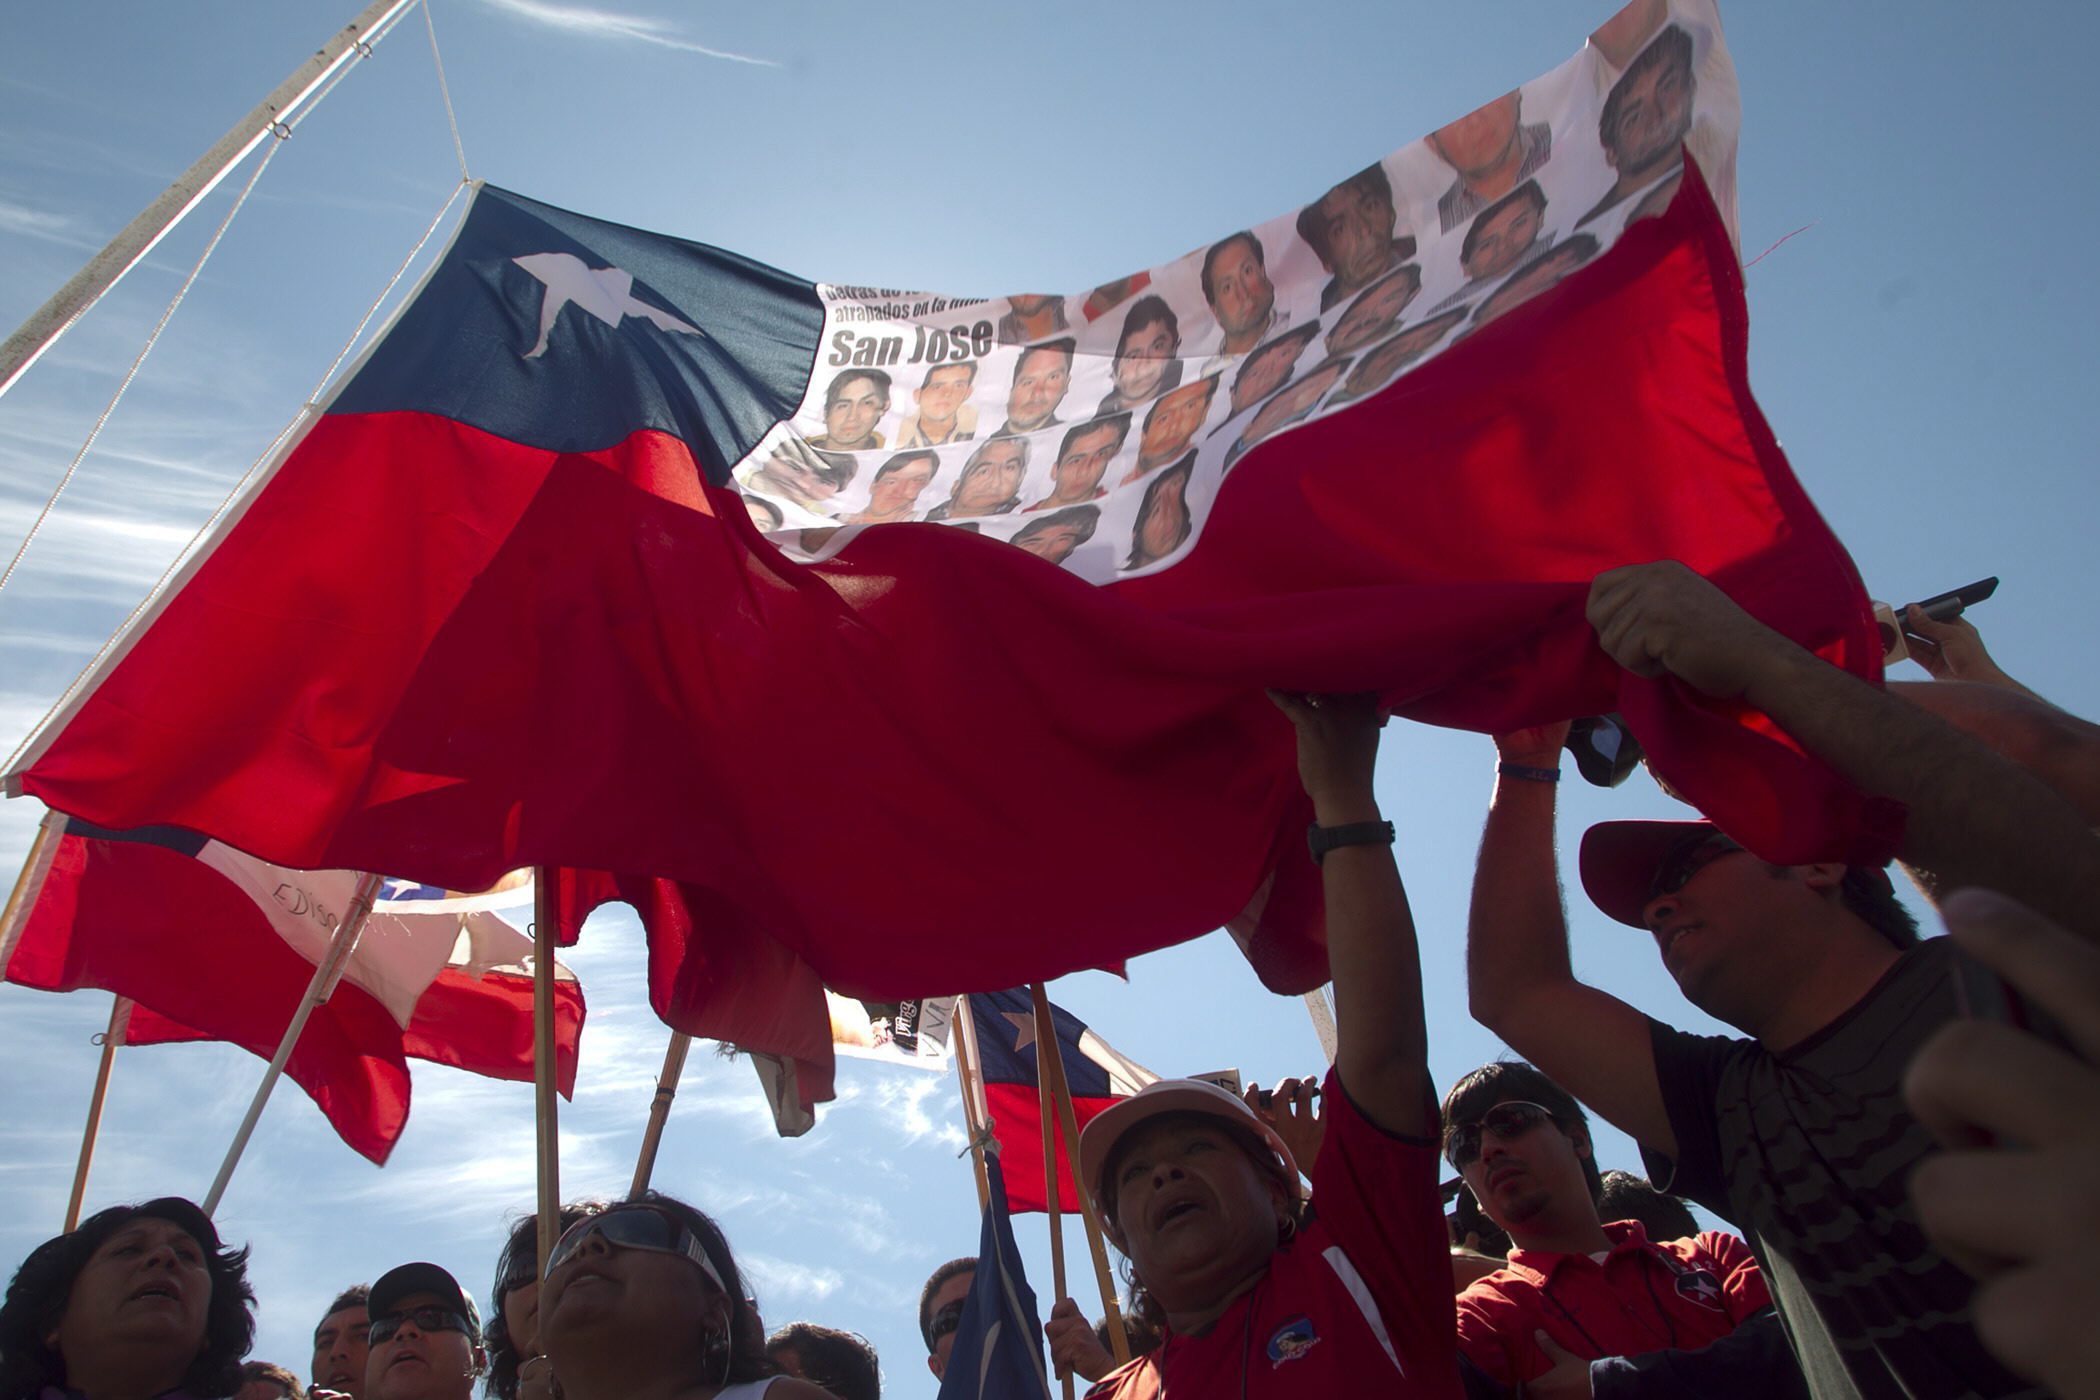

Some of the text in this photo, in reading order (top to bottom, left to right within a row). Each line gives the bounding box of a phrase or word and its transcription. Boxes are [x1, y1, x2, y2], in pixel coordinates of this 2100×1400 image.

[835, 302, 910, 323] atrapados
[931, 297, 946, 314] la
[828, 320, 993, 367] San Jose
